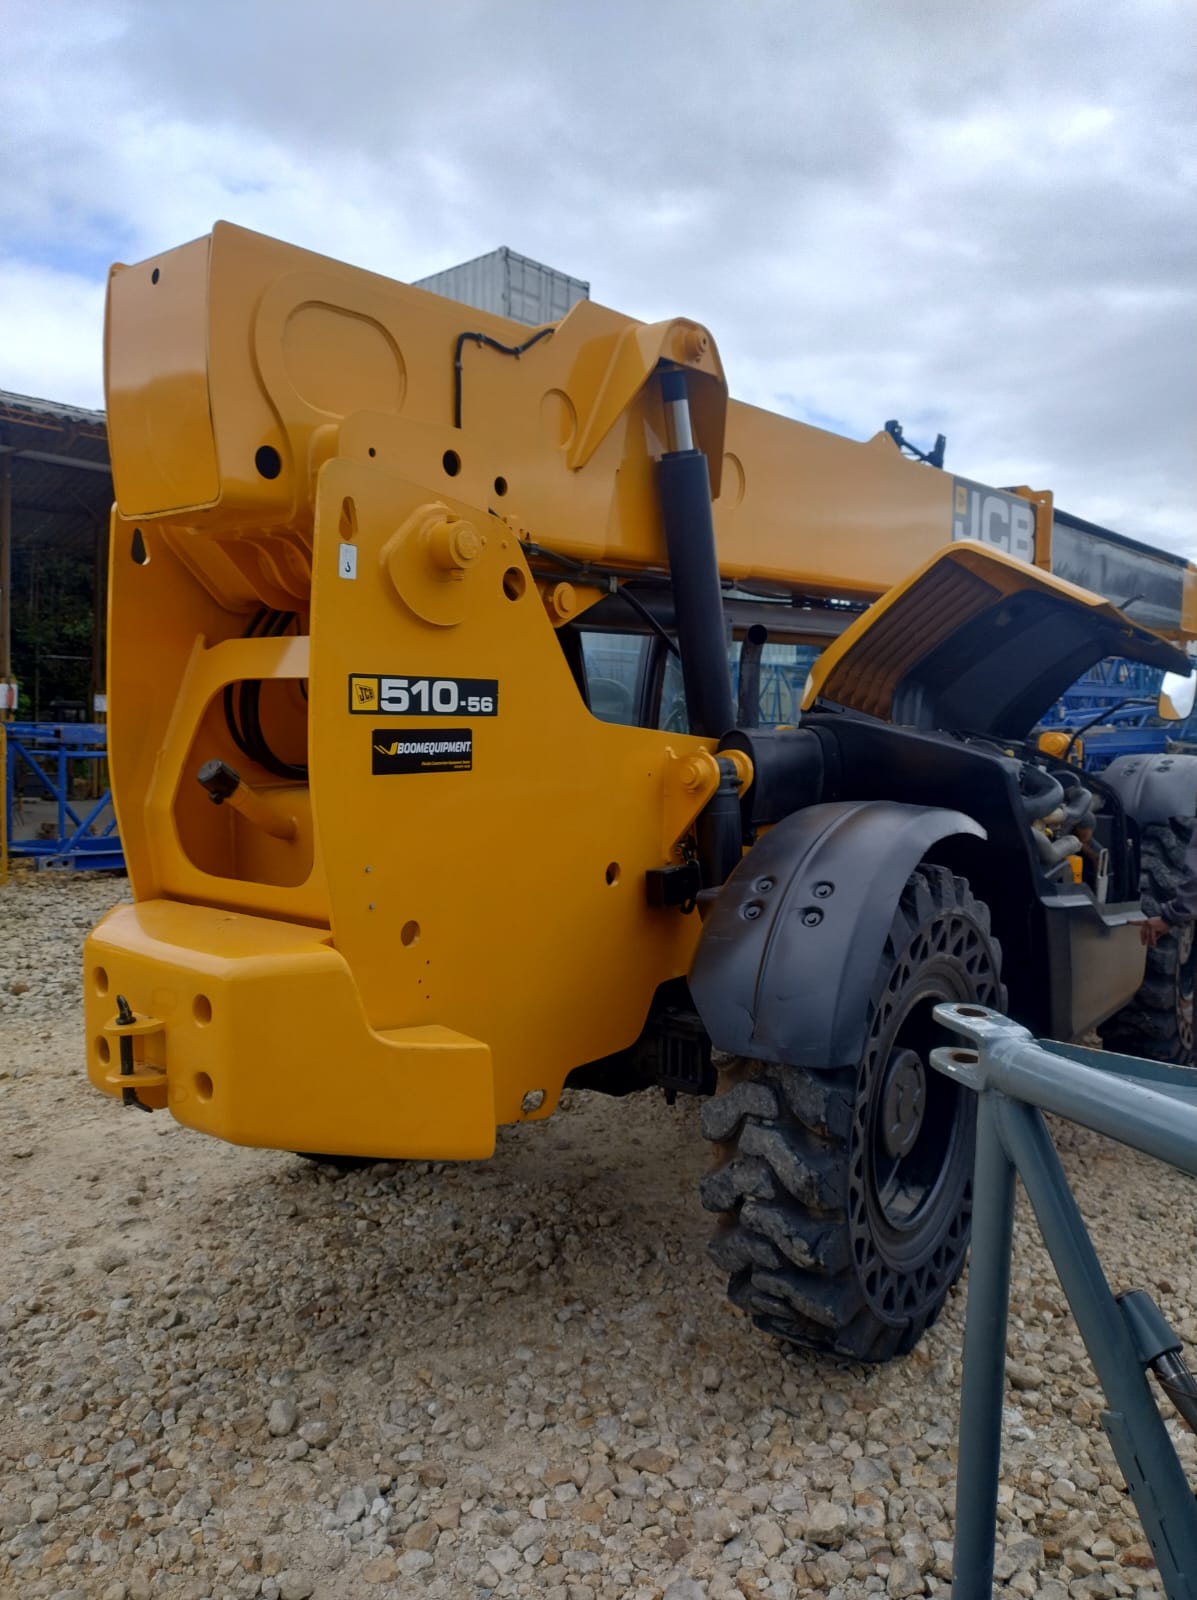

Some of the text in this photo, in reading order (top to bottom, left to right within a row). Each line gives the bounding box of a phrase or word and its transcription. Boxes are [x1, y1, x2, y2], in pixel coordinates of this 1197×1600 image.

[954, 490, 1035, 564] JCB
[357, 686, 374, 702] JCB
[397, 741, 471, 755] BOOMEQUIPMENT
